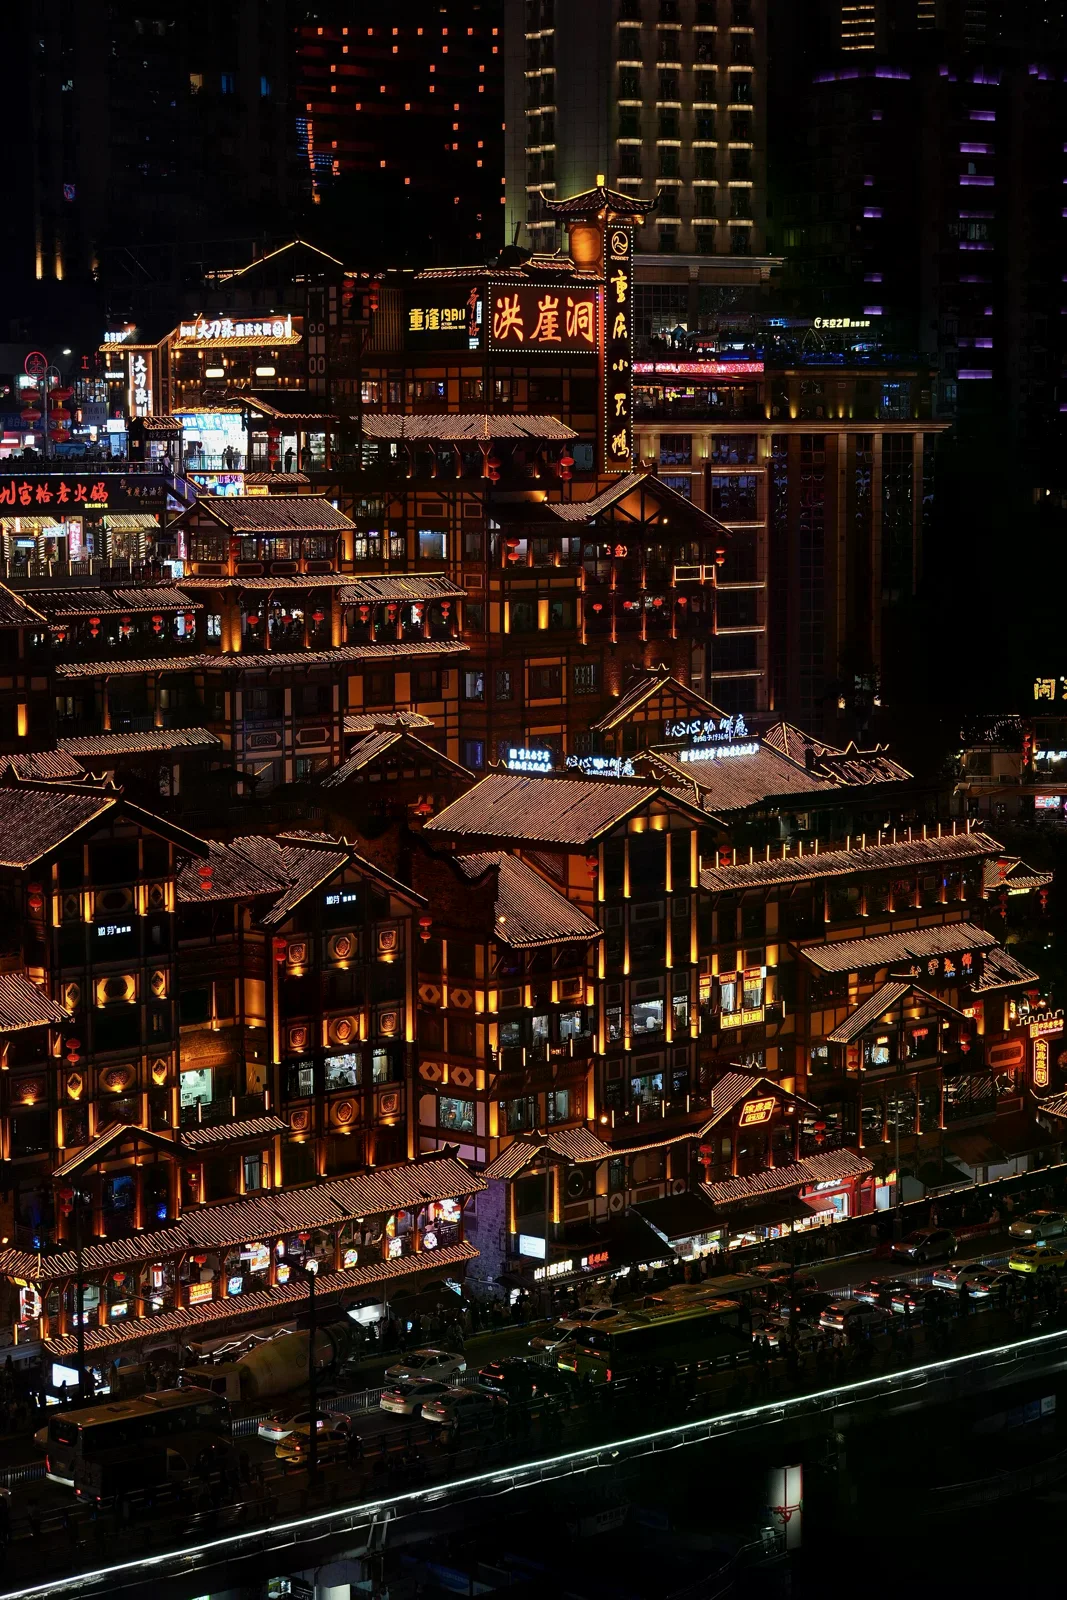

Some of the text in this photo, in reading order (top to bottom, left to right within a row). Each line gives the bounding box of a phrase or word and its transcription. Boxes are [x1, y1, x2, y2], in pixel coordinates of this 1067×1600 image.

[494, 294, 594, 343] 洪崖洞
[0, 481, 109, 505] 九宫格老火锅
